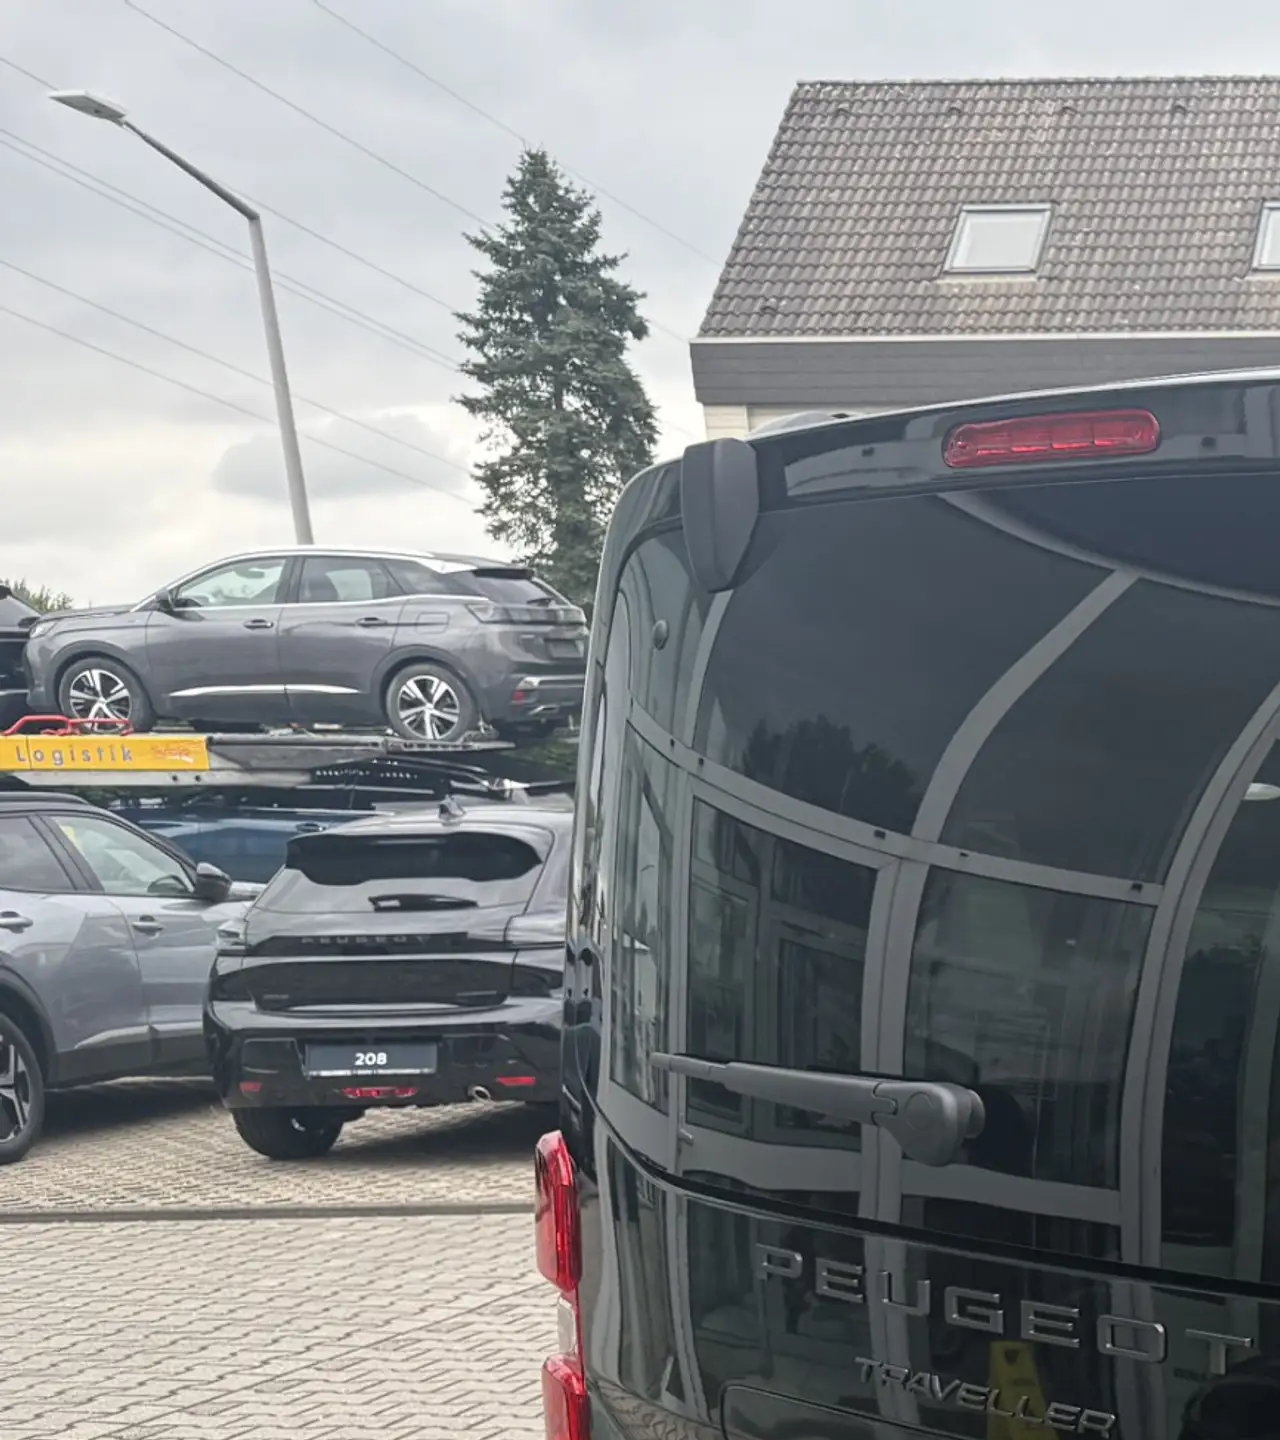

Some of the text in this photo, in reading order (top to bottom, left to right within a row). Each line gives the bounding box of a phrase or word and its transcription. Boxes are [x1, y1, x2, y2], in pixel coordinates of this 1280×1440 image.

[15, 744, 133, 766] Logistik
[354, 1052, 387, 1066] 208
[755, 1243, 1254, 1376] PEUGEOT
[854, 1356, 1117, 1440] TRAVELLER
